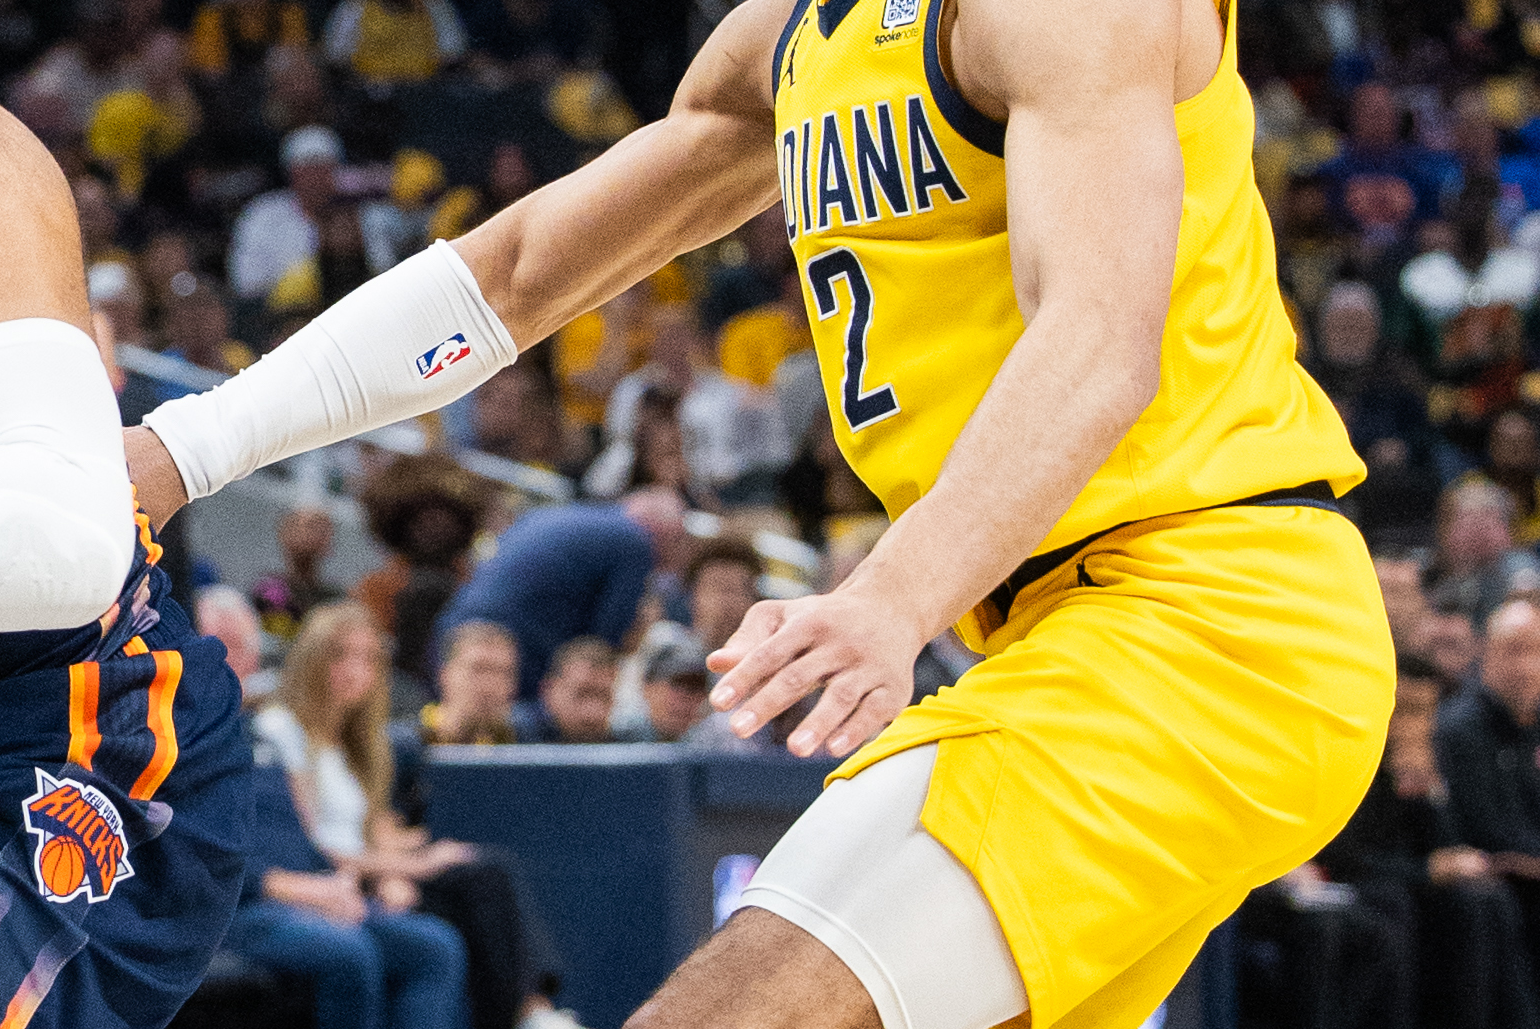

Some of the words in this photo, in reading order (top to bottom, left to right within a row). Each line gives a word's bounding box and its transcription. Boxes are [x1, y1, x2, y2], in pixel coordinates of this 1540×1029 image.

[806, 245, 901, 434] 2
[29, 785, 125, 895] KNICKS
[83, 790, 105, 811] NEW
[101, 807, 122, 834] YORK
